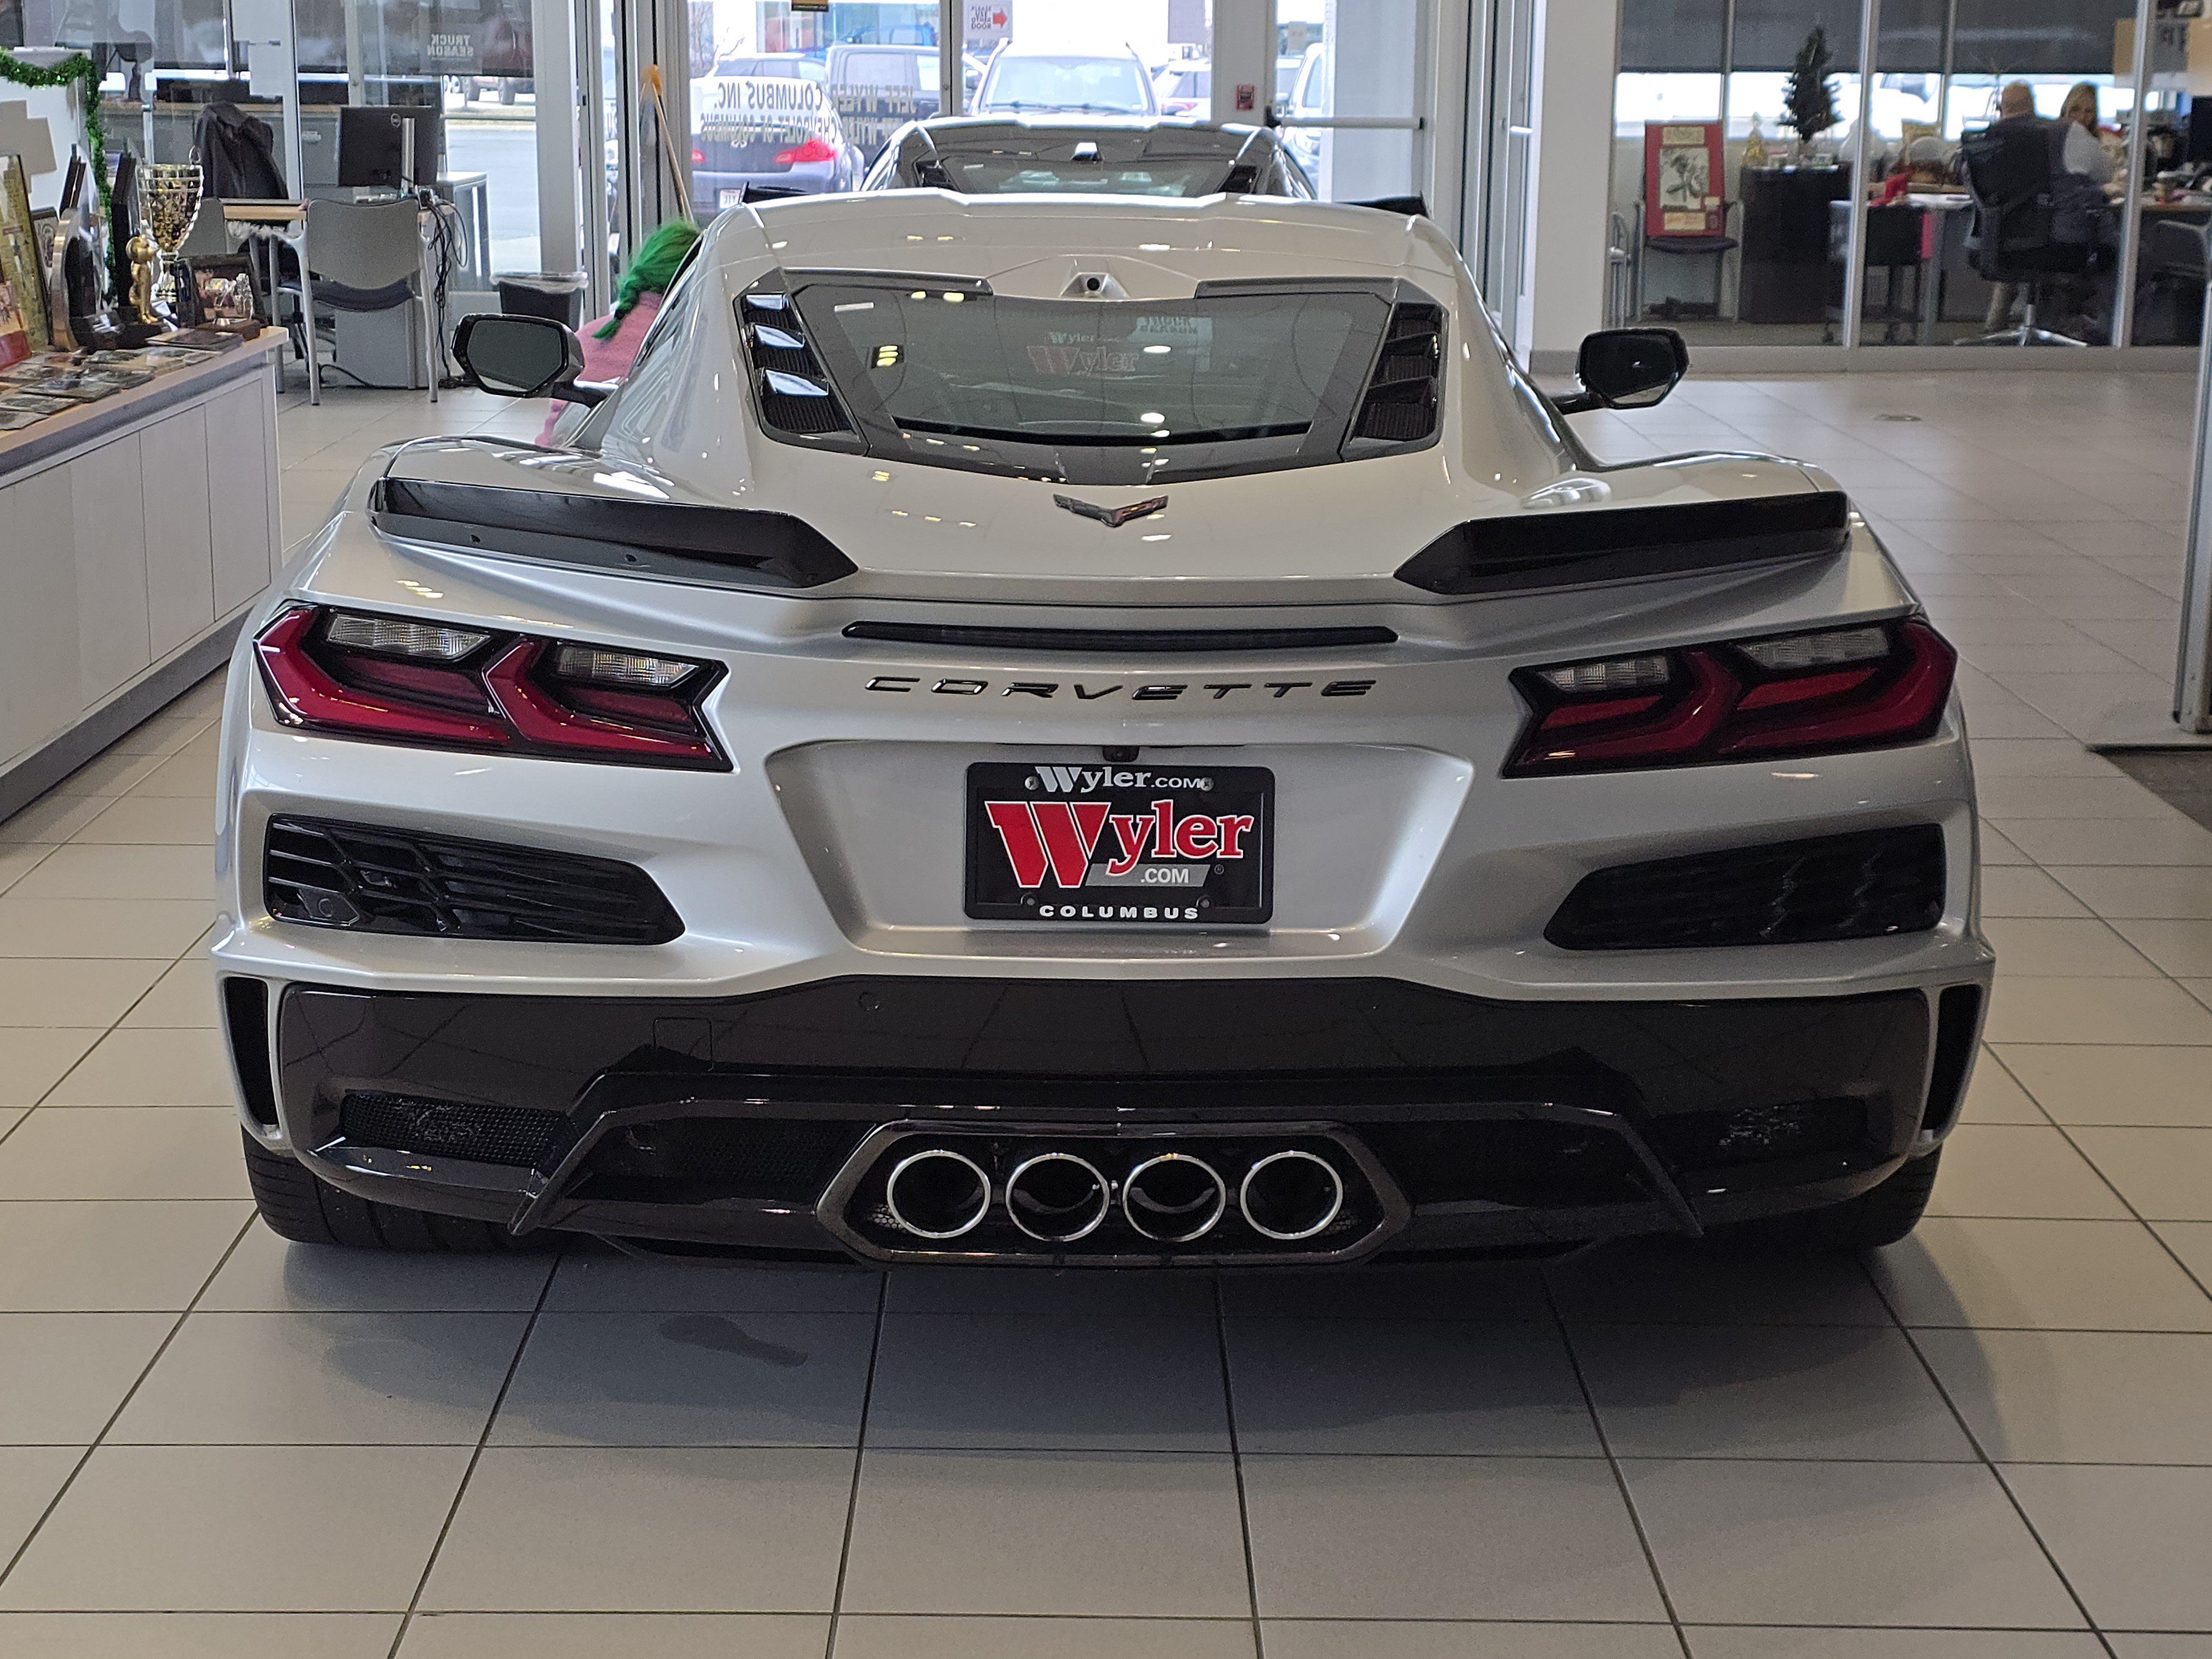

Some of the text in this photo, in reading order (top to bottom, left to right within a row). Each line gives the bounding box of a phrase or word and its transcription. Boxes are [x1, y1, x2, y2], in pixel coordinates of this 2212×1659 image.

[1026, 345, 1140, 377] Wyler
[864, 676, 1376, 700] CORVETTE
[984, 799, 1255, 888] Wyler
[1039, 905, 1198, 920] COLUMBUS
